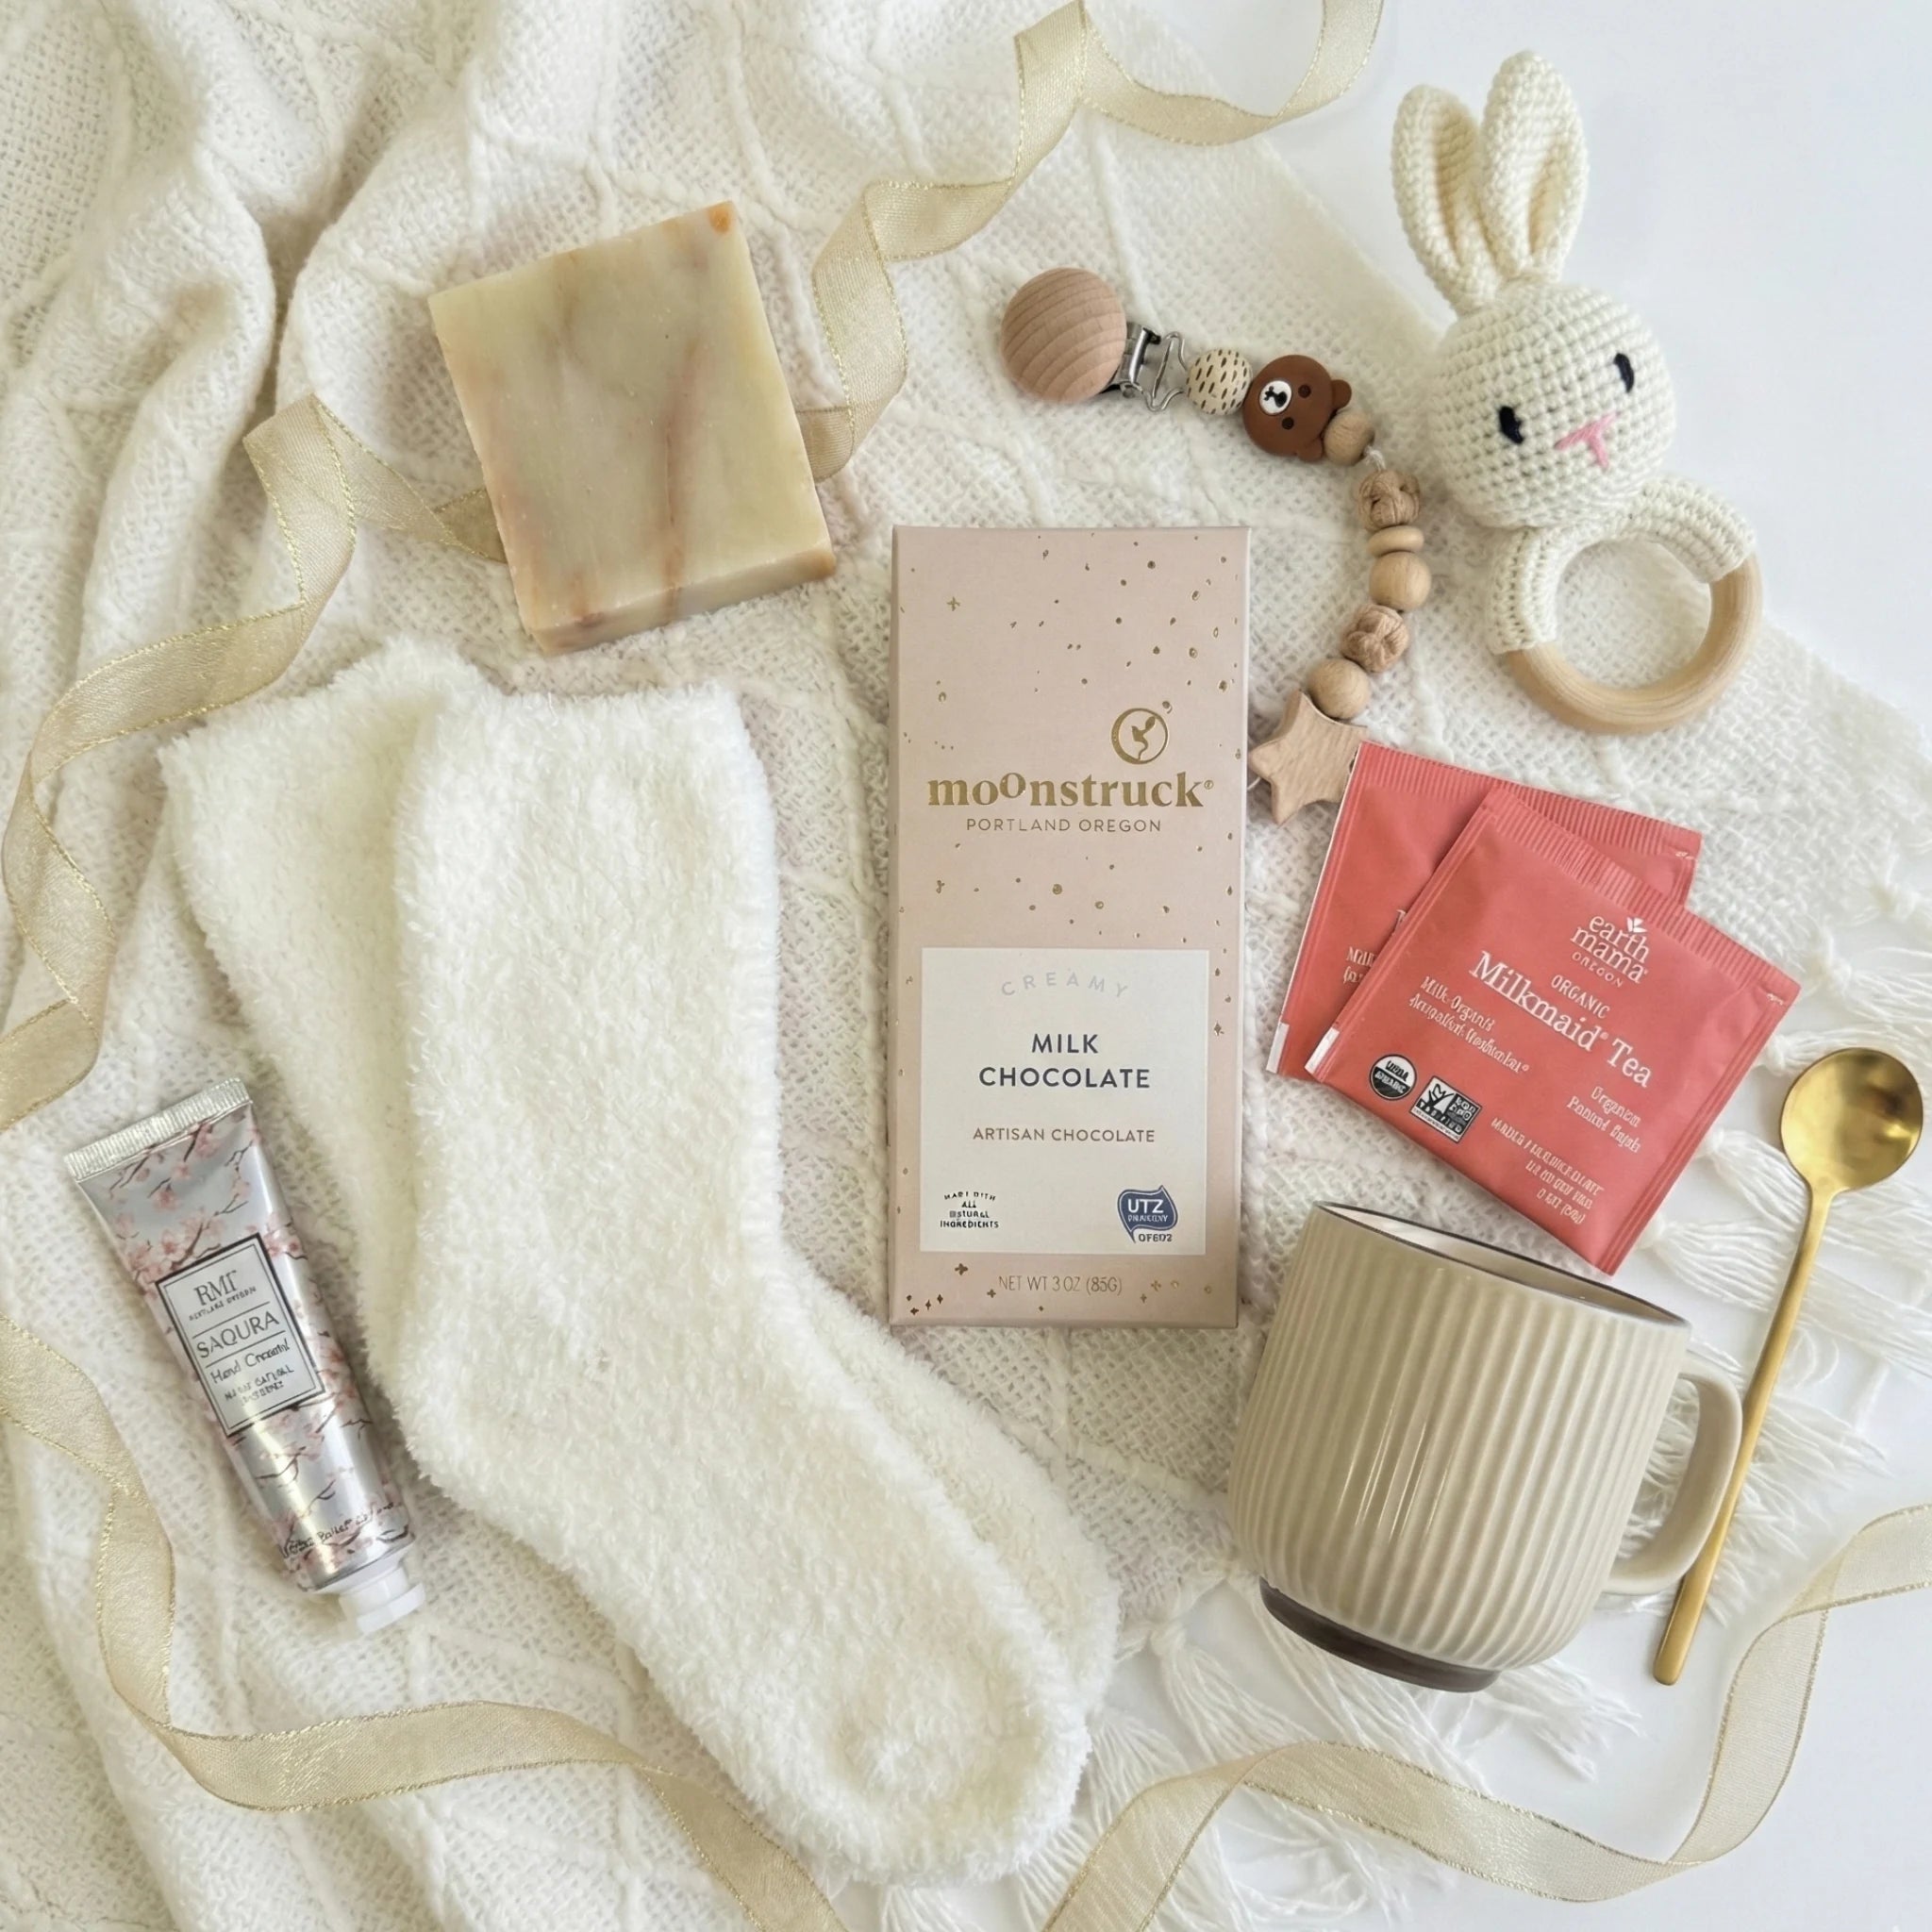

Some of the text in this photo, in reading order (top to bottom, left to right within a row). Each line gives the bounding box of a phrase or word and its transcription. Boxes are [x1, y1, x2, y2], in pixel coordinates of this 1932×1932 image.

[966, 818, 1161, 832] PORTLAND OREGON
[1589, 915, 1650, 964] earth
[1001, 971, 1128, 998] CREAMY
[1550, 974, 1610, 1019] ORGANIC
[1031, 1034, 1099, 1055] MILK
[1607, 1038, 1652, 1088] Tea
[978, 1067, 1151, 1089] CHOCOLATE
[973, 1127, 1156, 1142] ARTISAN CHOCOLATE
[1127, 1198, 1164, 1214] UTZ
[998, 1275, 1123, 1296] NET WT 3 OZ (85G)
[196, 1310, 280, 1358] SAQURA
